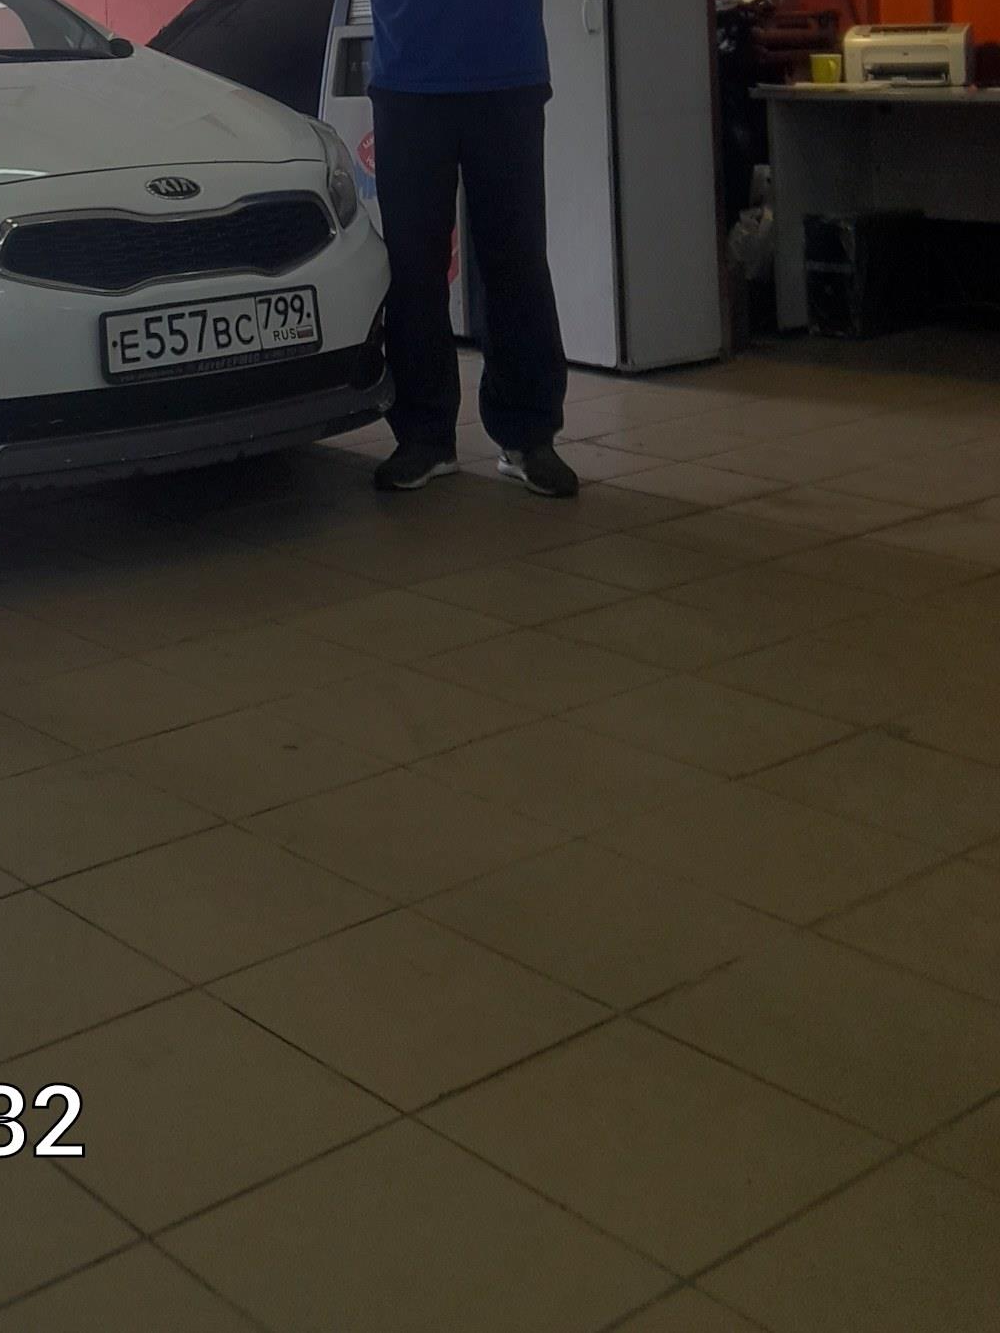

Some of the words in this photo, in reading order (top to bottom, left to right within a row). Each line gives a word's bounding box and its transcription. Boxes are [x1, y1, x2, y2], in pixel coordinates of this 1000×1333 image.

[157, 178, 196, 193] KIA
[257, 293, 305, 330] 799
[272, 327, 297, 342] RUS
